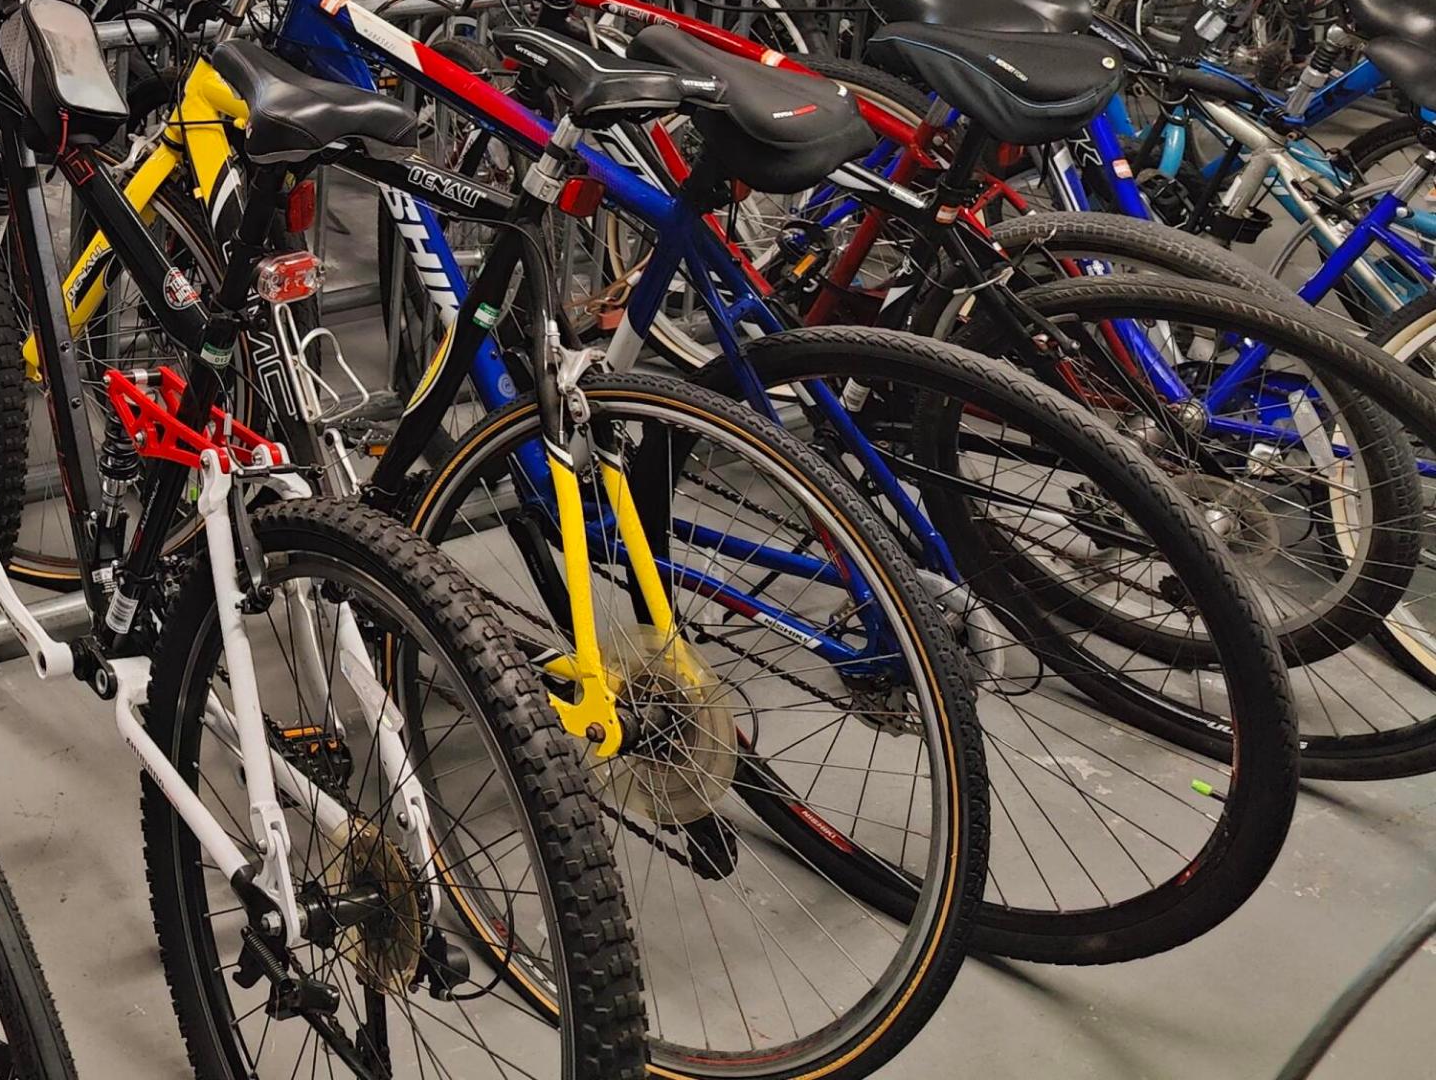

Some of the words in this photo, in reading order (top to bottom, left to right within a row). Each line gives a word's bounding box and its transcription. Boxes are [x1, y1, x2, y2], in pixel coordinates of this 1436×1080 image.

[407, 165, 482, 208] DENALI
[66, 244, 102, 302] DENALI
[764, 617, 808, 642] NISHIKI
